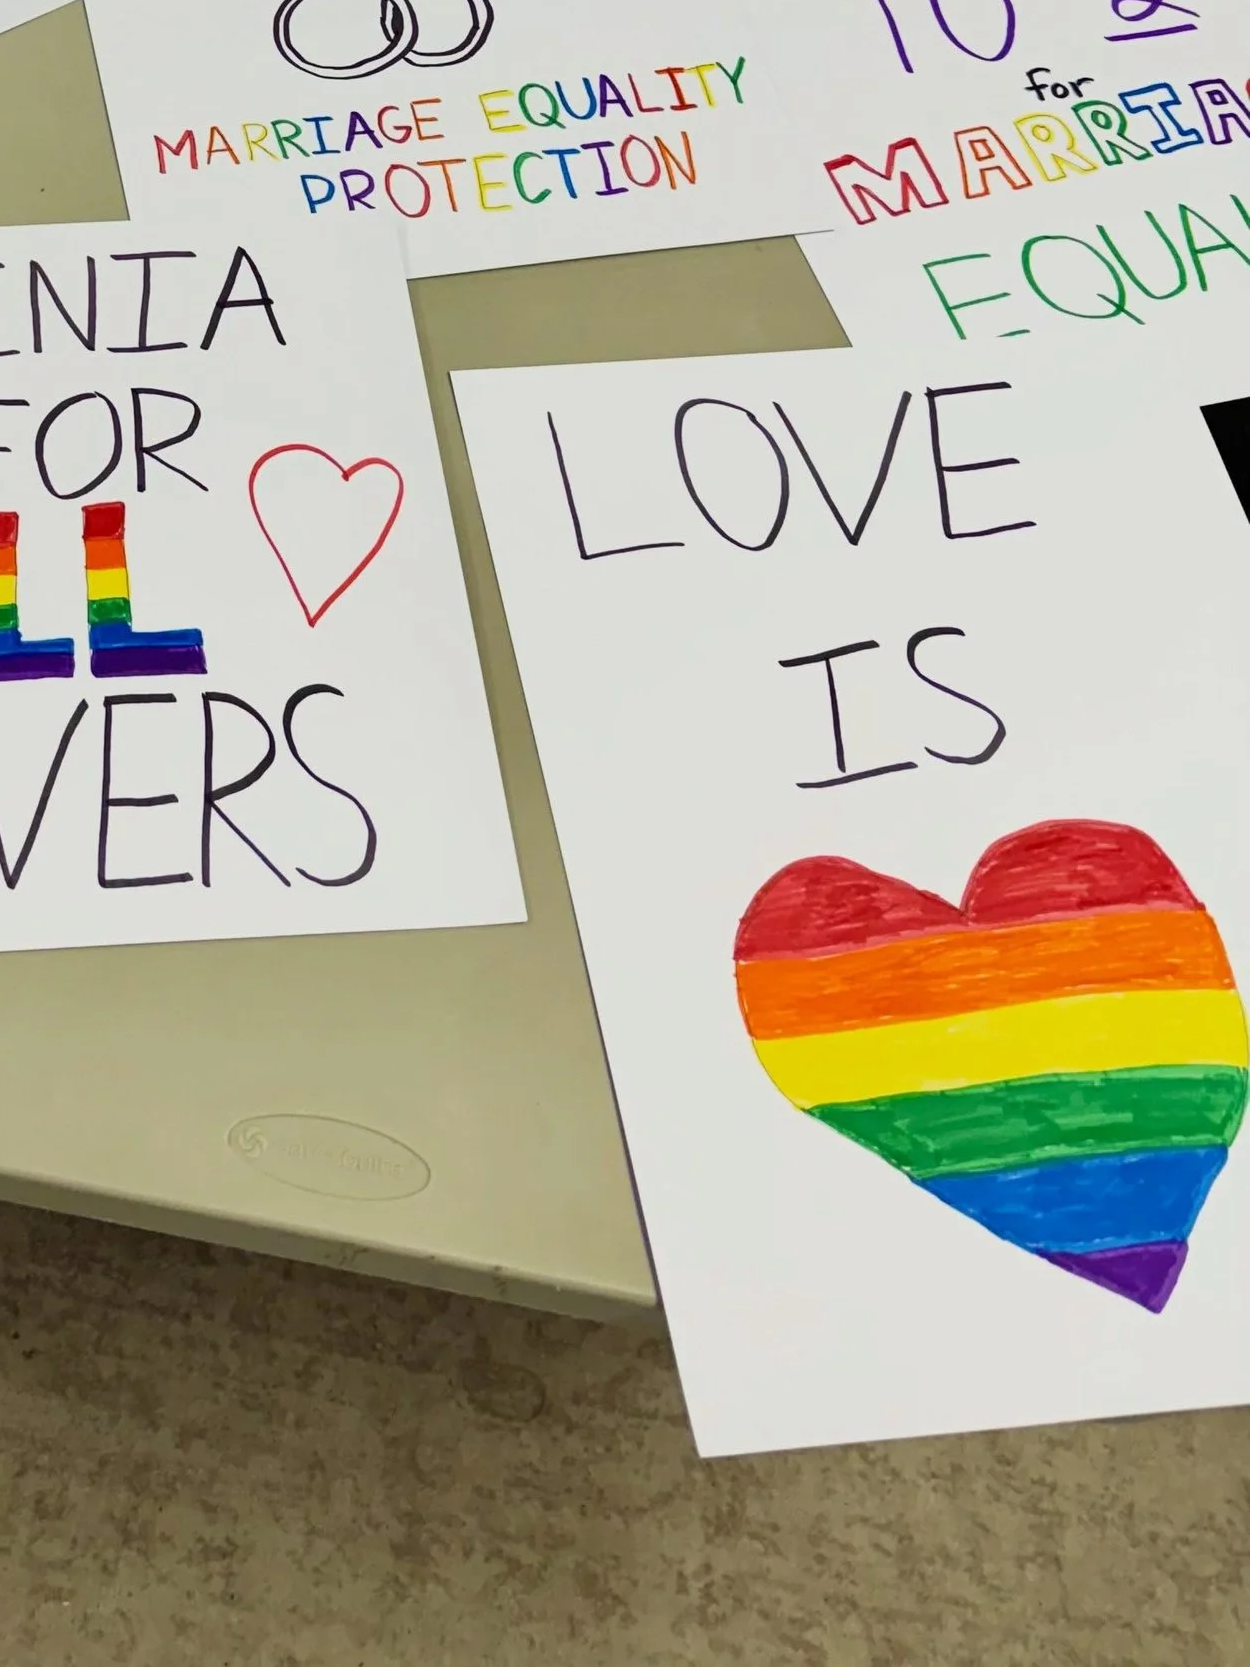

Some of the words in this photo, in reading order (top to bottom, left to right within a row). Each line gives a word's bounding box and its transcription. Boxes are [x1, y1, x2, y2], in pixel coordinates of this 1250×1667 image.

[154, 98, 445, 174] MARRIAGE
[479, 56, 746, 134] EQUALITY
[823, 75, 1250, 225] MARRIA
[1024, 67, 1094, 102] for
[299, 131, 698, 219] PROTECTION
[548, 381, 1038, 560] LOVE
[778, 626, 1007, 789] IS
